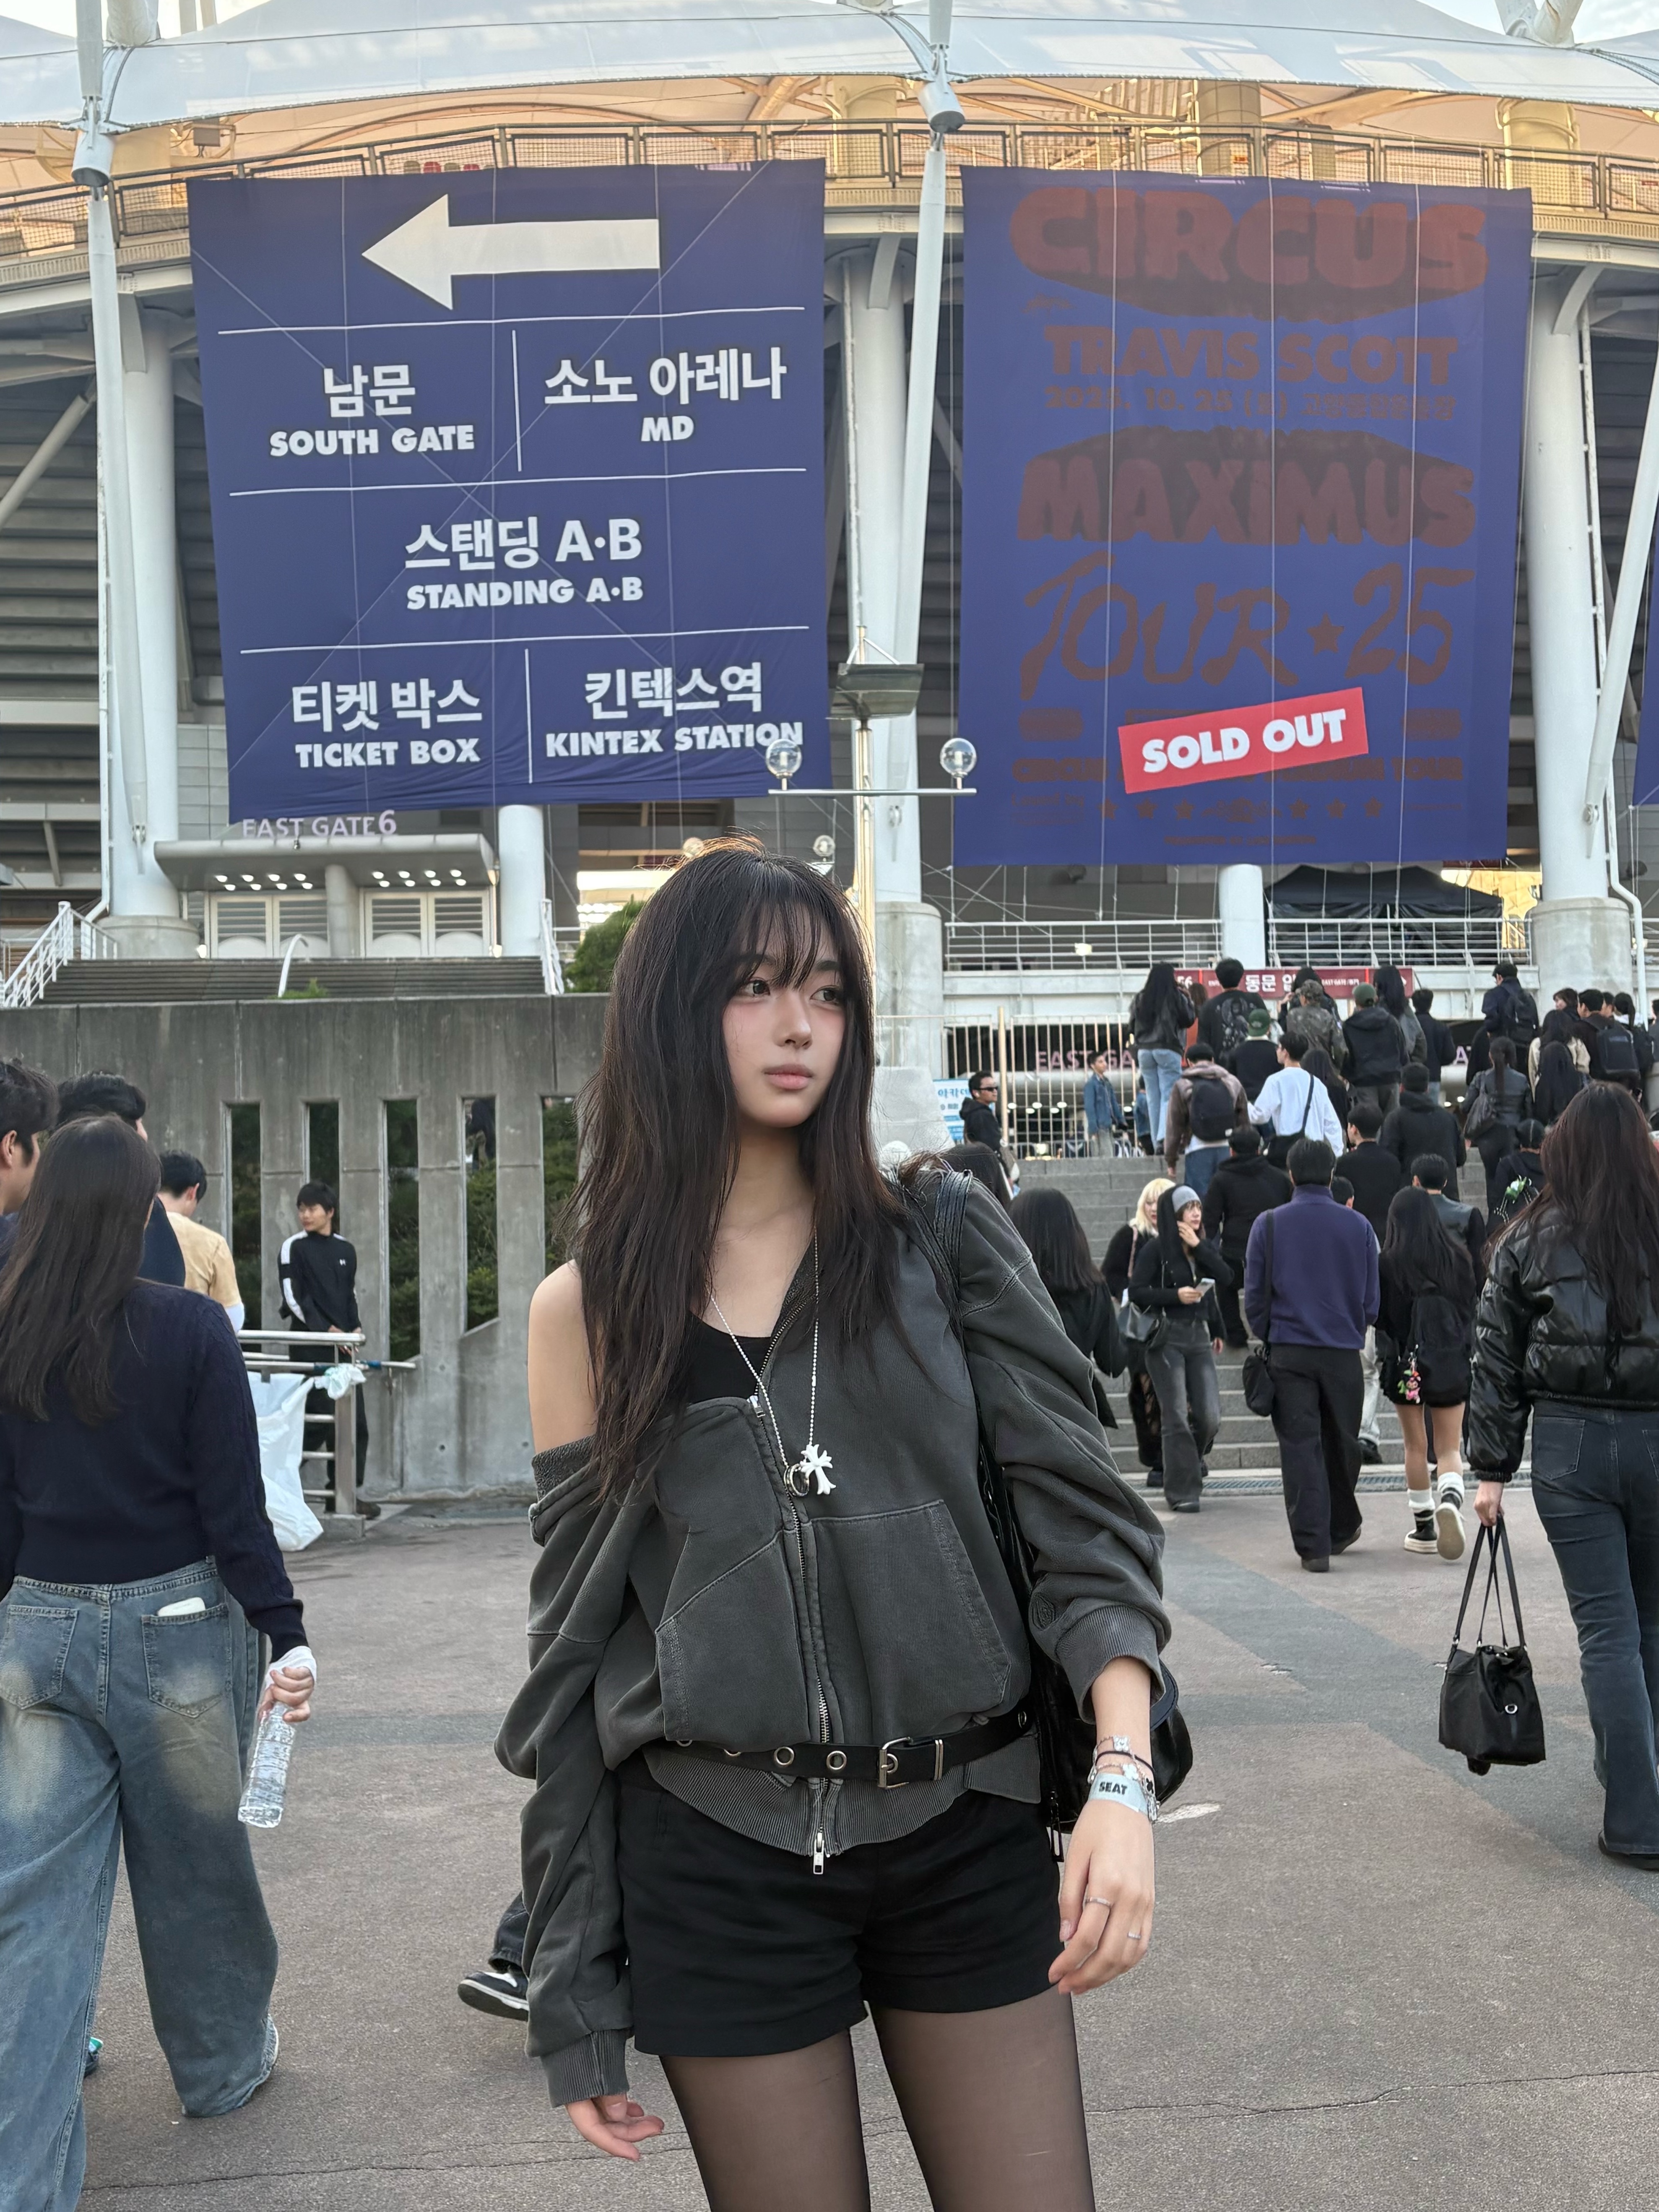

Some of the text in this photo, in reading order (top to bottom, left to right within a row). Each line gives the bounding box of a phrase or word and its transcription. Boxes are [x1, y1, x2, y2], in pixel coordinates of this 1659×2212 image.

[1010, 186, 1490, 293] CIRCUS
[545, 347, 787, 405] 소노 아레나
[1044, 325, 1458, 385] TRAVIS SCOTT
[324, 365, 416, 417] 남문
[1044, 385, 1131, 410] 2025.
[1144, 387, 1185, 411] 10.
[1194, 388, 1233, 412] 25
[270, 425, 474, 456] SOUTH GATE
[641, 416, 694, 442] MD
[1017, 455, 1476, 548] MAXIMUS
[405, 516, 539, 570] 스탠딩
[407, 579, 574, 610] STANDING
[1019, 549, 1475, 701] TOUR 25
[292, 678, 482, 732] 티켓 박스
[585, 662, 761, 719] 킨텍스역
[295, 738, 480, 768] TICKET BOX
[546, 721, 803, 757] KINTEX STATION
[1142, 727, 1250, 773] SOLD
[1263, 708, 1346, 752] OUT
[242, 809, 397, 838] EAST GATE 6
[1246, 974, 1297, 992] 동문 입
[1036, 1049, 1135, 1070] EAST GA
[1099, 1781, 1128, 1796] SEAT
